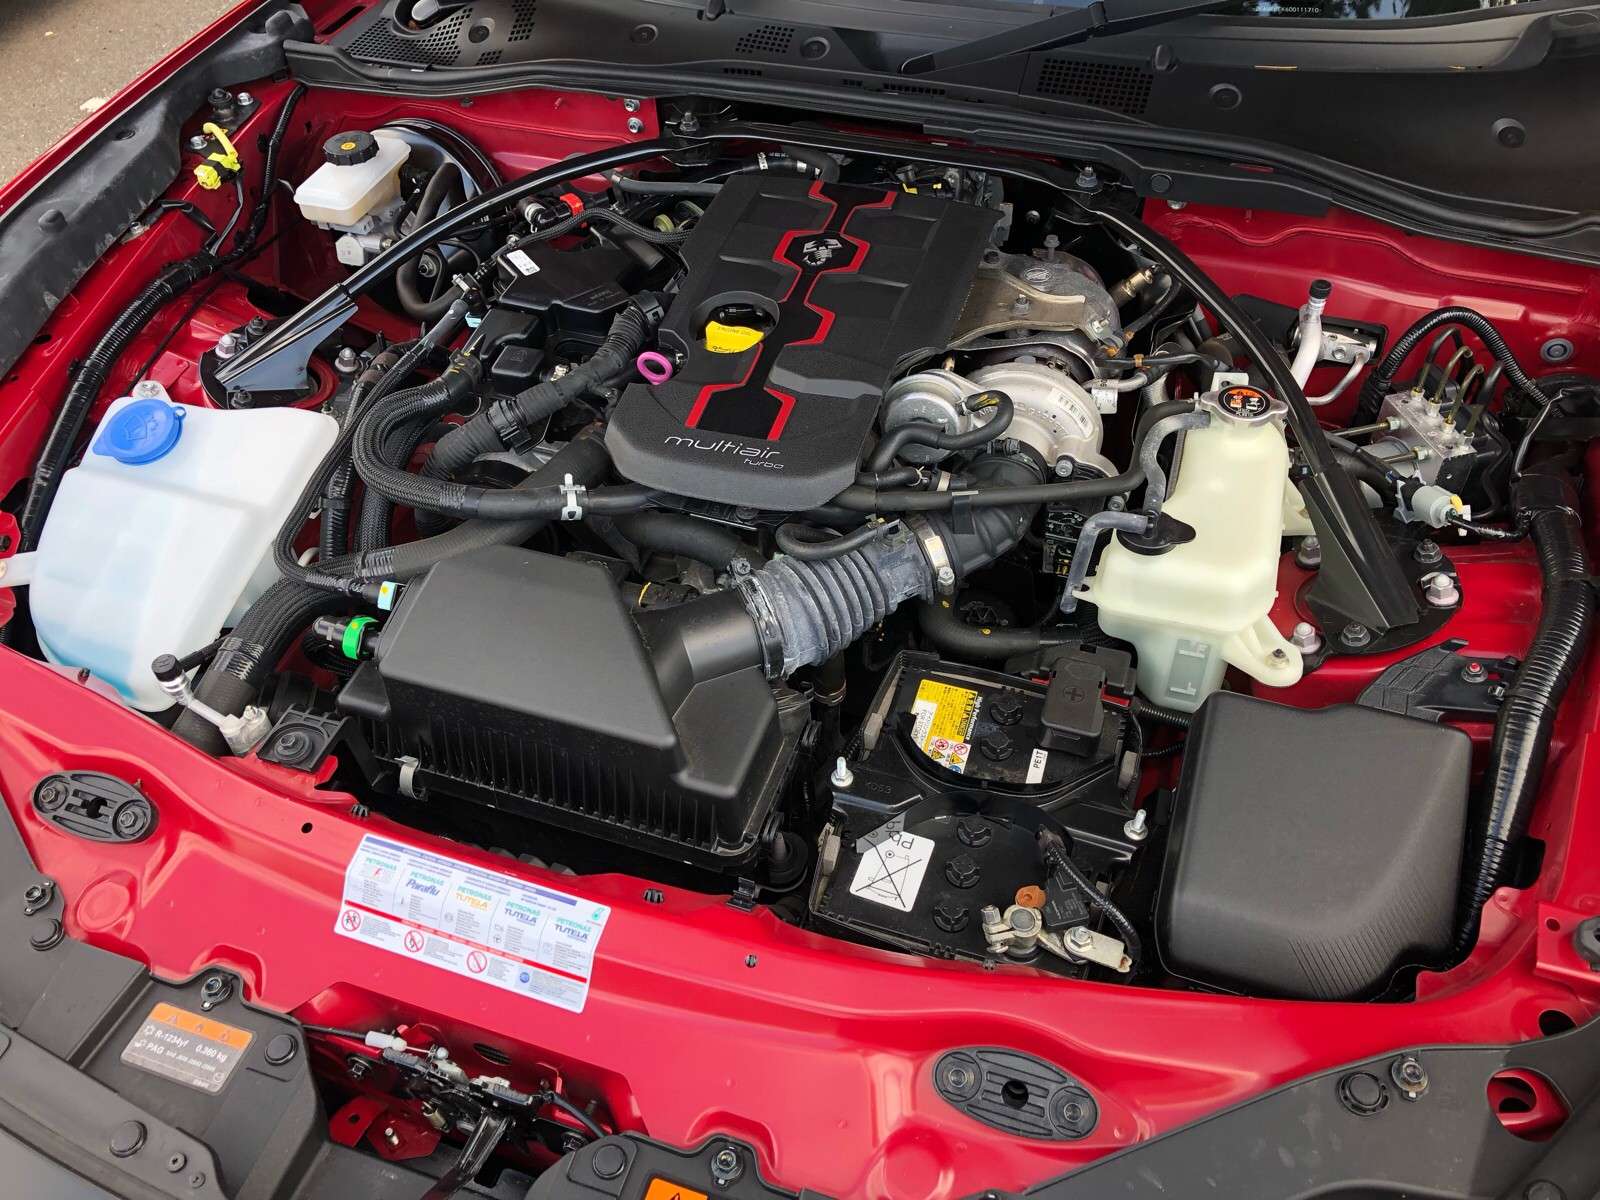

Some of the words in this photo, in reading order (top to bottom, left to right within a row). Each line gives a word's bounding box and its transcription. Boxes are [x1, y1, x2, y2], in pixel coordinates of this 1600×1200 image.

[664, 435, 780, 459] multiair
[744, 458, 784, 469] turbo
[965, 708, 979, 740] Performance
[410, 870, 444, 886] PETRONAS
[405, 879, 441, 897] Paraflu
[457, 886, 492, 901] PETRONAS
[456, 893, 488, 909] TUTELA
[505, 901, 541, 916] PETRONAS
[504, 908, 537, 923] TUTELA
[555, 924, 588, 940] TUTELA
[556, 917, 592, 932] PETRONAS
